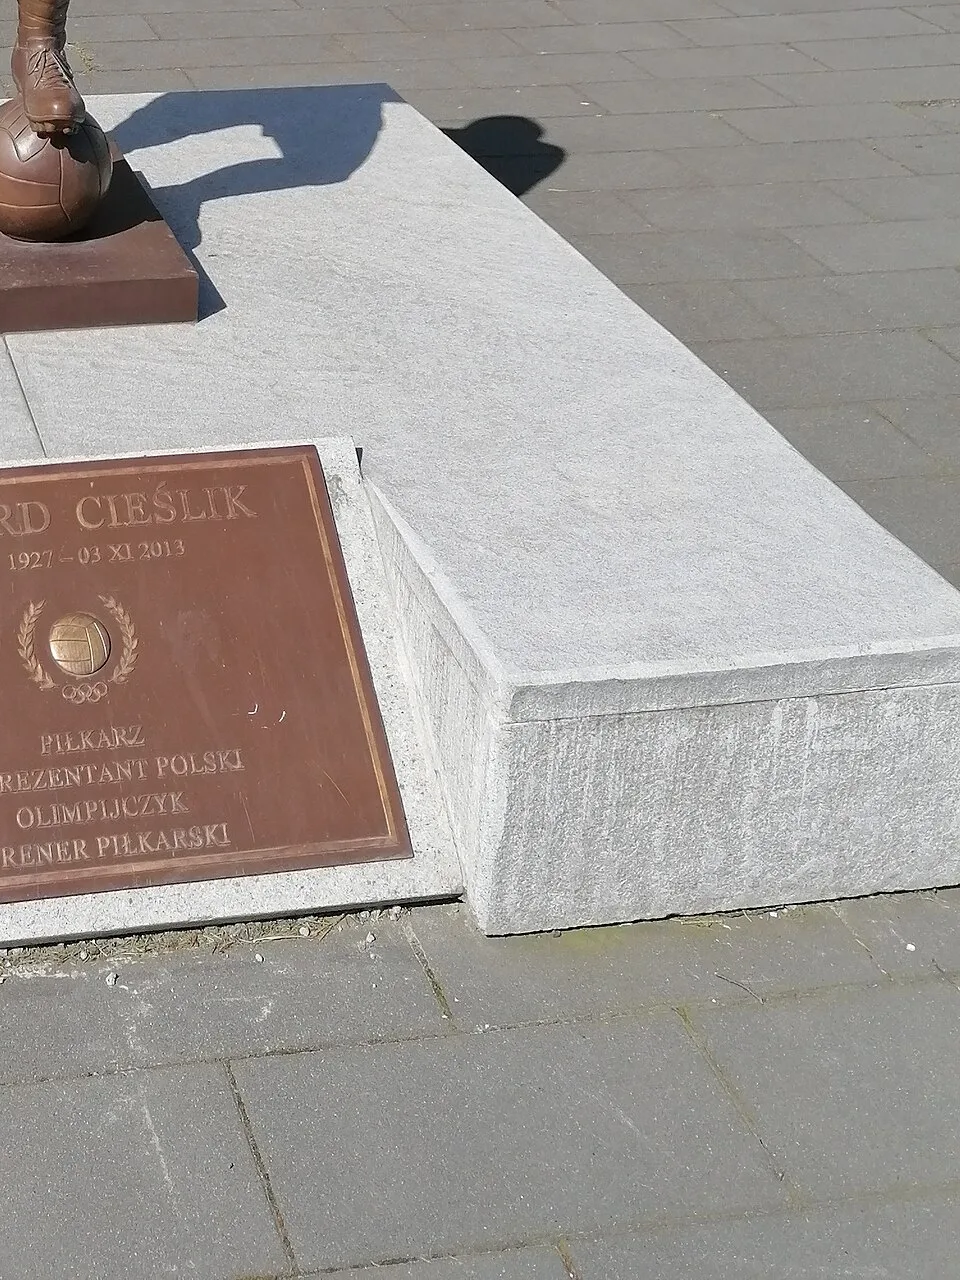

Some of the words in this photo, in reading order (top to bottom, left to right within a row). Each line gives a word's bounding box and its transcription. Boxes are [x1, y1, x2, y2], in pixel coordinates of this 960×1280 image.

[76, 481, 258, 530] CIEŚLIK
[8, 549, 54, 571] 1927
[77, 545, 102, 565] 03
[108, 542, 135, 563] XI
[139, 538, 186, 561] 2013
[40, 726, 145, 756] PIŁKARZ
[155, 749, 245, 780] POLSKI
[16, 791, 190, 829] OLIMPIJCZYK
[96, 822, 232, 858] PIŁKARSKI
